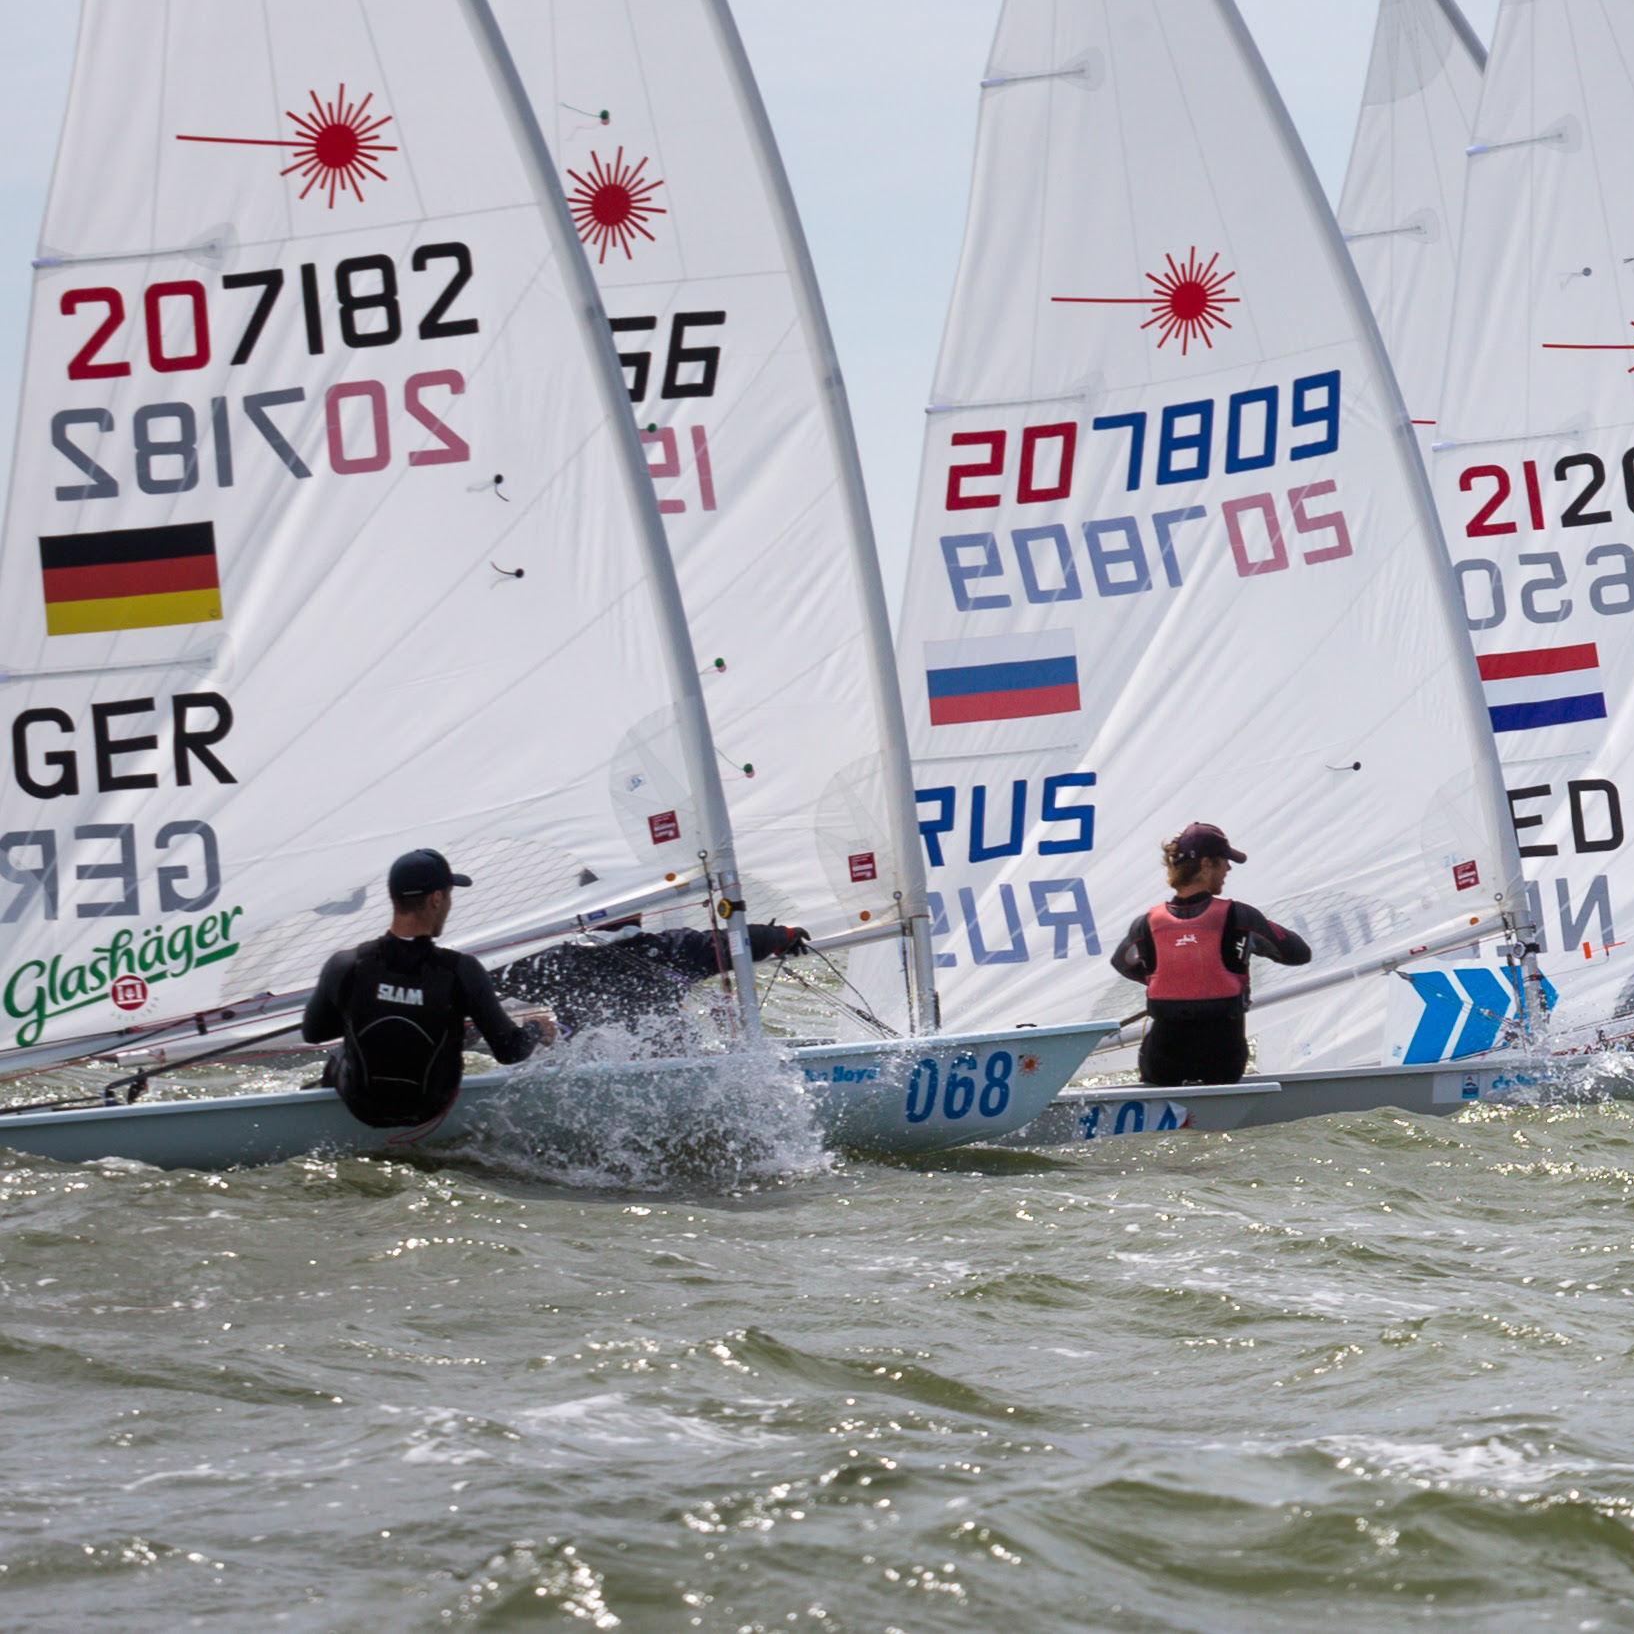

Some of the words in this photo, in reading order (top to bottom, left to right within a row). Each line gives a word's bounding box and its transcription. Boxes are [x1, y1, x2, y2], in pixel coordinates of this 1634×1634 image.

[59, 241, 480, 380] 207182
[945, 369, 1341, 511] 207809
[12, 691, 239, 800] GER
[914, 771, 1097, 867] RUS
[3, 905, 243, 1047] Glashäger
[377, 983, 424, 1006] SLAM
[906, 1050, 1013, 1123] 068
